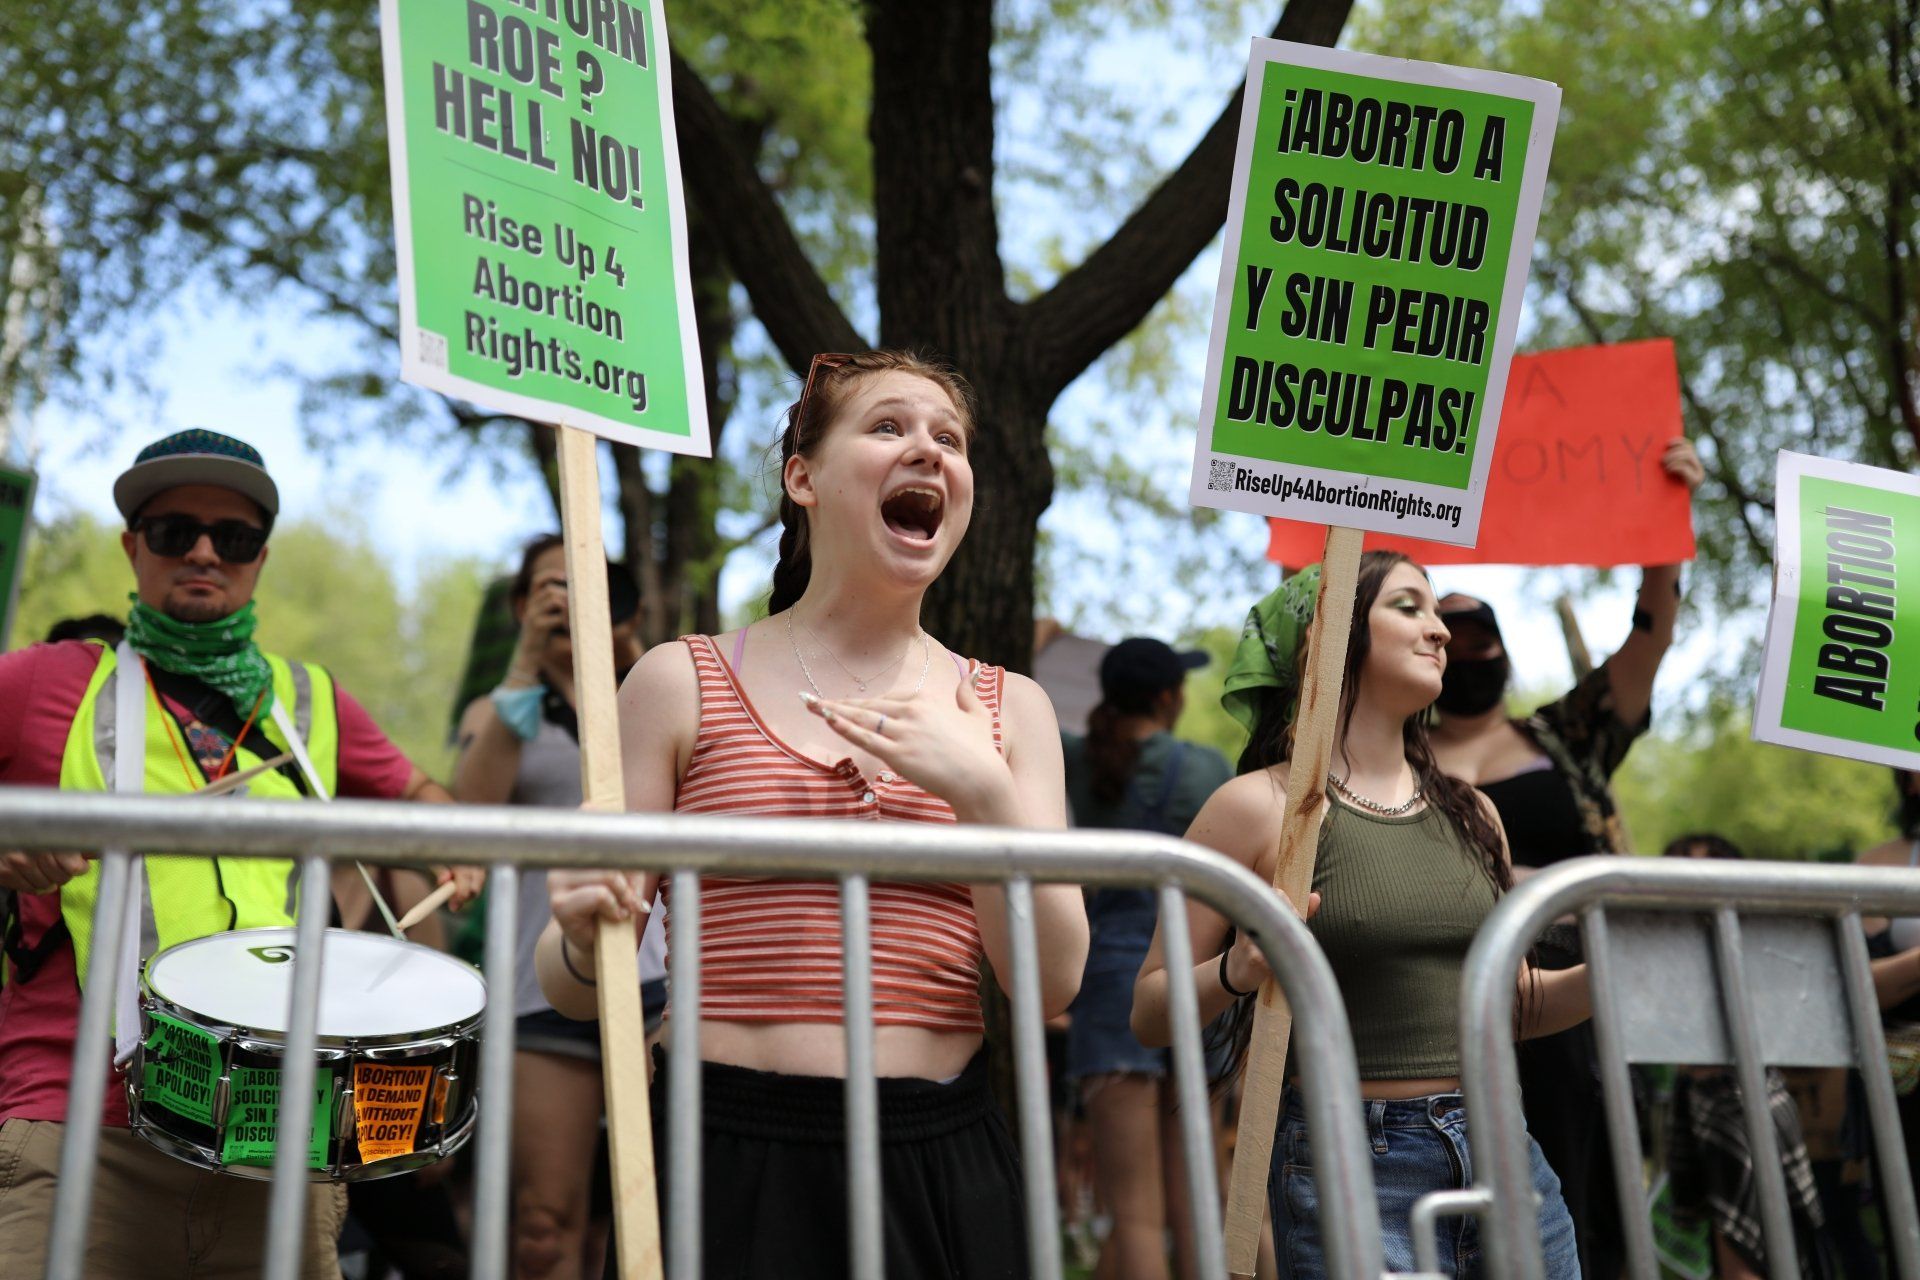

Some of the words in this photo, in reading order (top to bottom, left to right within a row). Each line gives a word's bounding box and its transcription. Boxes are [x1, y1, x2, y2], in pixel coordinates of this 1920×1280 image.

[467, 0, 564, 99] ROE
[433, 61, 557, 173] HELL
[570, 117, 644, 211] NO!
[1278, 87, 1465, 174] ¡ABORTO
[1474, 115, 1507, 183] A
[463, 193, 544, 256] Rise
[554, 223, 596, 282] Up
[604, 246, 626, 288] 4
[1270, 178, 1490, 272] SOLICITUD
[473, 256, 625, 342] Abortion
[1246, 265, 1273, 332] Y
[1280, 273, 1355, 346] SIN
[1363, 285, 1491, 366] PEDIR
[464, 310, 648, 413] Rights.org
[1228, 356, 1476, 455] DISCULPAS!
[1235, 468, 1463, 527] RiseUp4AbortionRights.org
[1813, 505, 1898, 713] ABORTION
[156, 1068, 211, 1107] APOLOGY!
[245, 1108, 267, 1123] SIN
[367, 1088, 422, 1103] DEMAND
